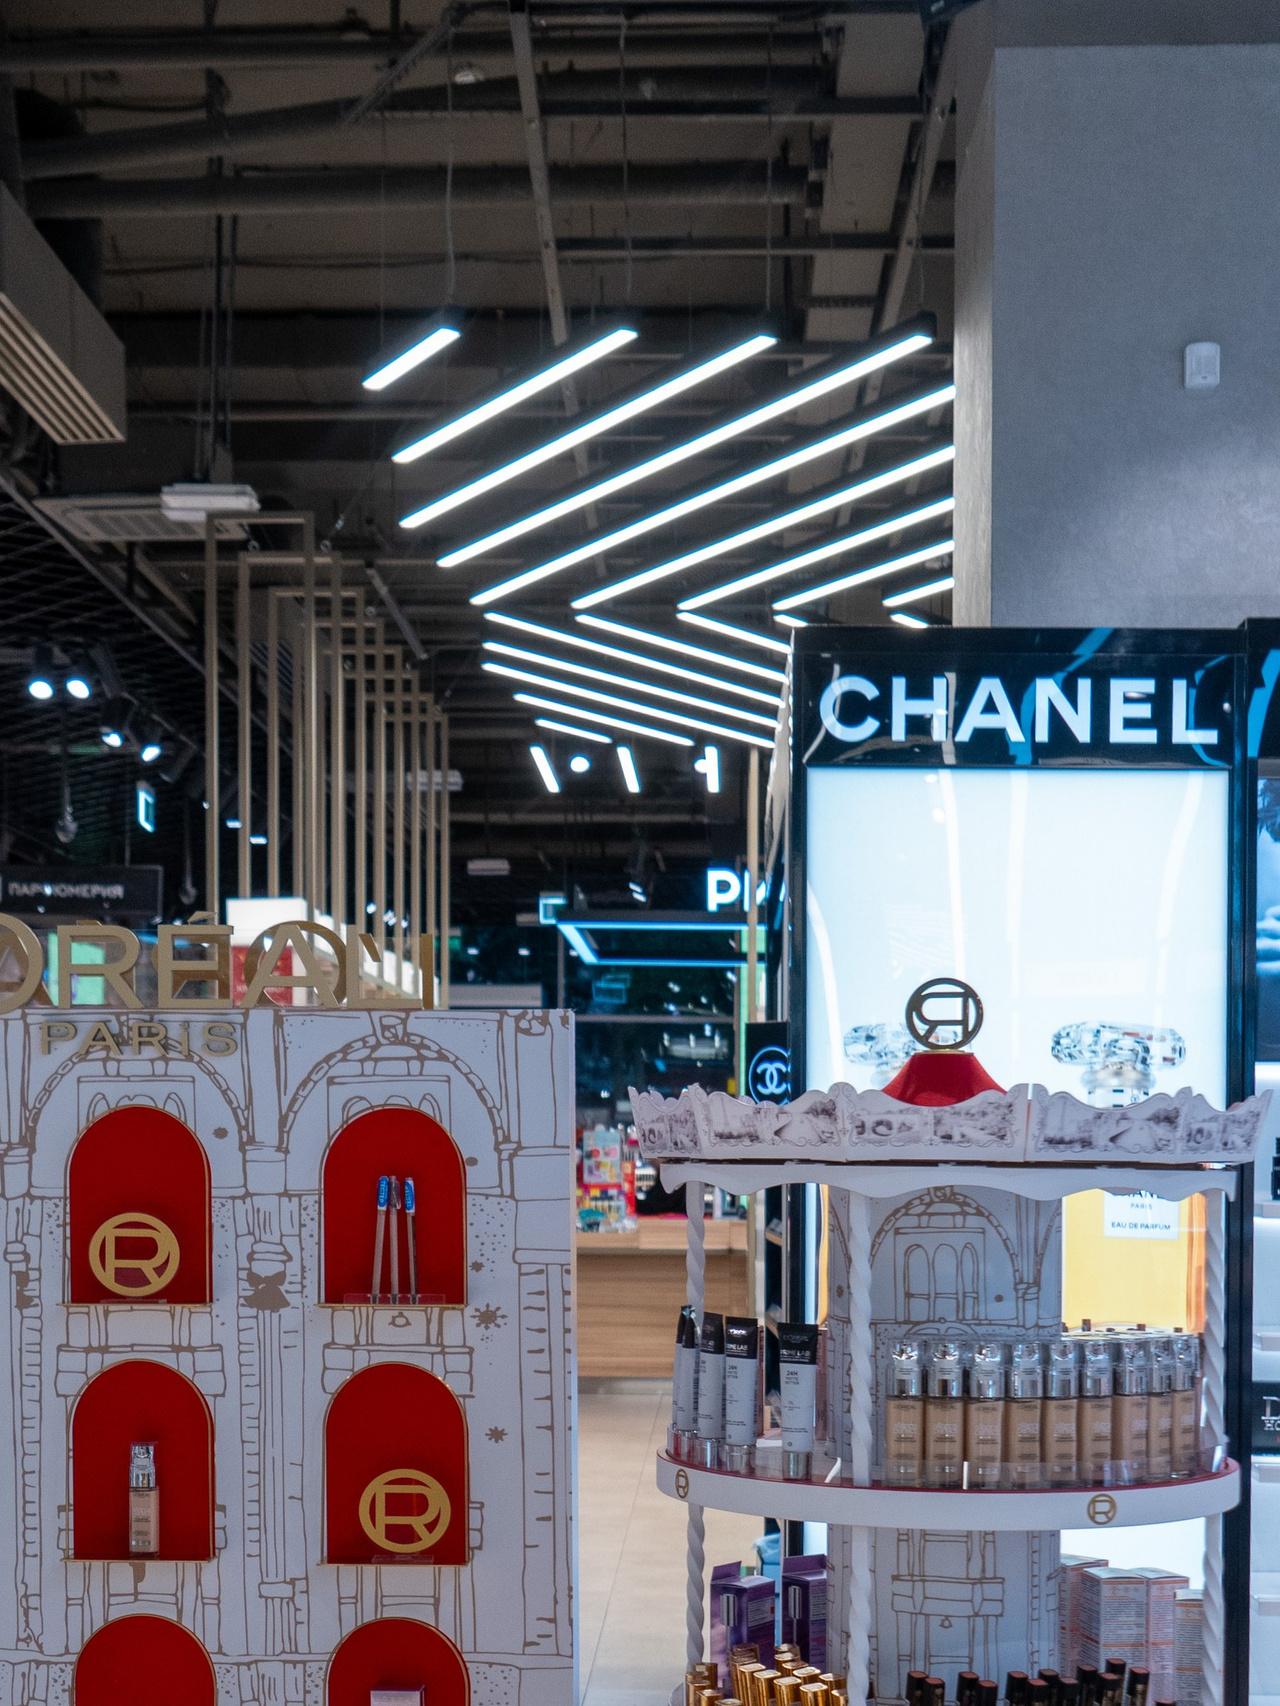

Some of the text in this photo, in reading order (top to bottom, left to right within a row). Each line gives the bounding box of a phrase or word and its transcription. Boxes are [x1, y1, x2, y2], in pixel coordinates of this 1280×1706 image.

[820, 674, 1218, 744] CHANEL
[8, 882, 125, 899] ПАРЮМЕРИЯ
[1111, 1221, 1127, 1229] EAU
[1140, 1222, 1171, 1230] PARFUM
